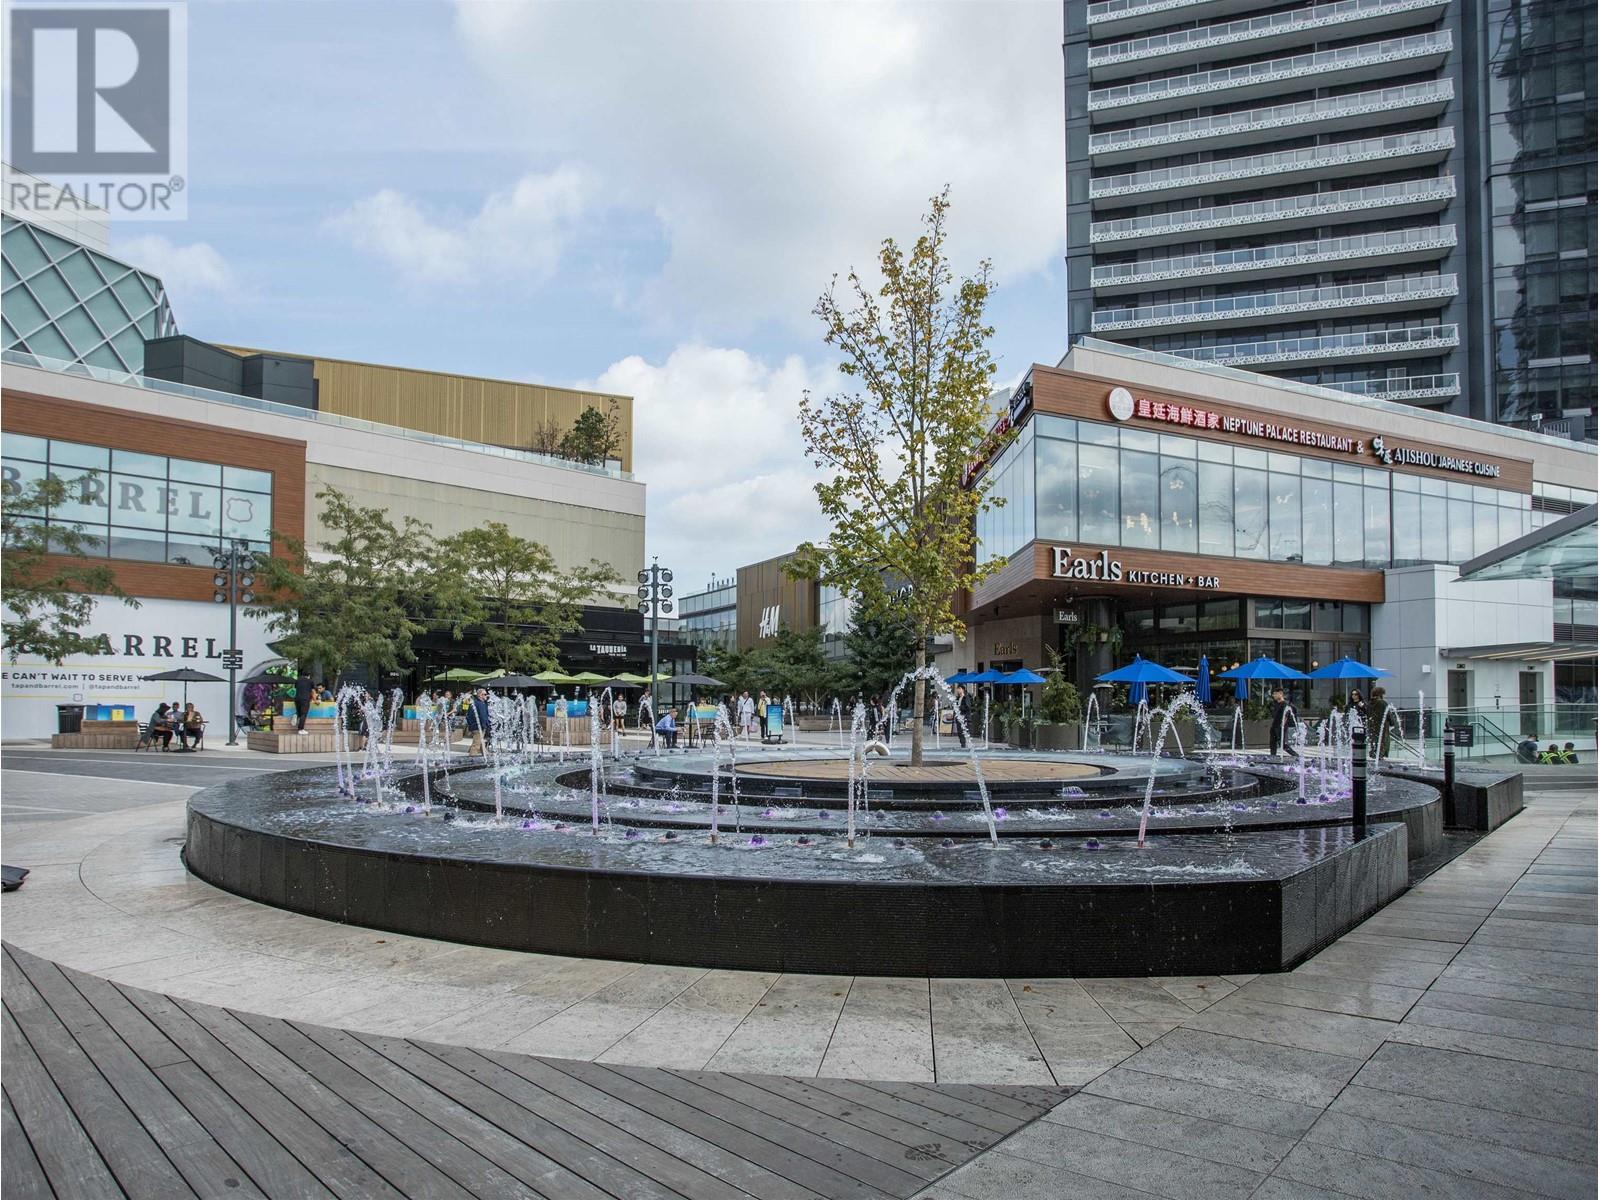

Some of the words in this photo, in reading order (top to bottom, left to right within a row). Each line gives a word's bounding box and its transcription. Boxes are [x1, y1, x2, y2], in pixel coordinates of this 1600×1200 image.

[1138, 399, 1220, 429] 皇廷海鮮酒家
[1223, 416, 1264, 437] NEPTUNE
[1266, 424, 1298, 442] PALACE
[1300, 430, 1352, 453] RESTAURANT
[1394, 447, 1438, 467] AJISHOU
[1438, 456, 1473, 473] JAPANESE
[1474, 463, 1500, 477] CUISINE
[1052, 546, 1122, 581] Earls
[1129, 570, 1184, 586] KITCHEN
[1198, 575, 1220, 588] BAR
[759, 604, 780, 638] H&M
[1059, 610, 1078, 621] Earls
[65, 631, 222, 659] ARREL
[51, 673, 78, 681] WAIT
[99, 674, 133, 682] SERVE
